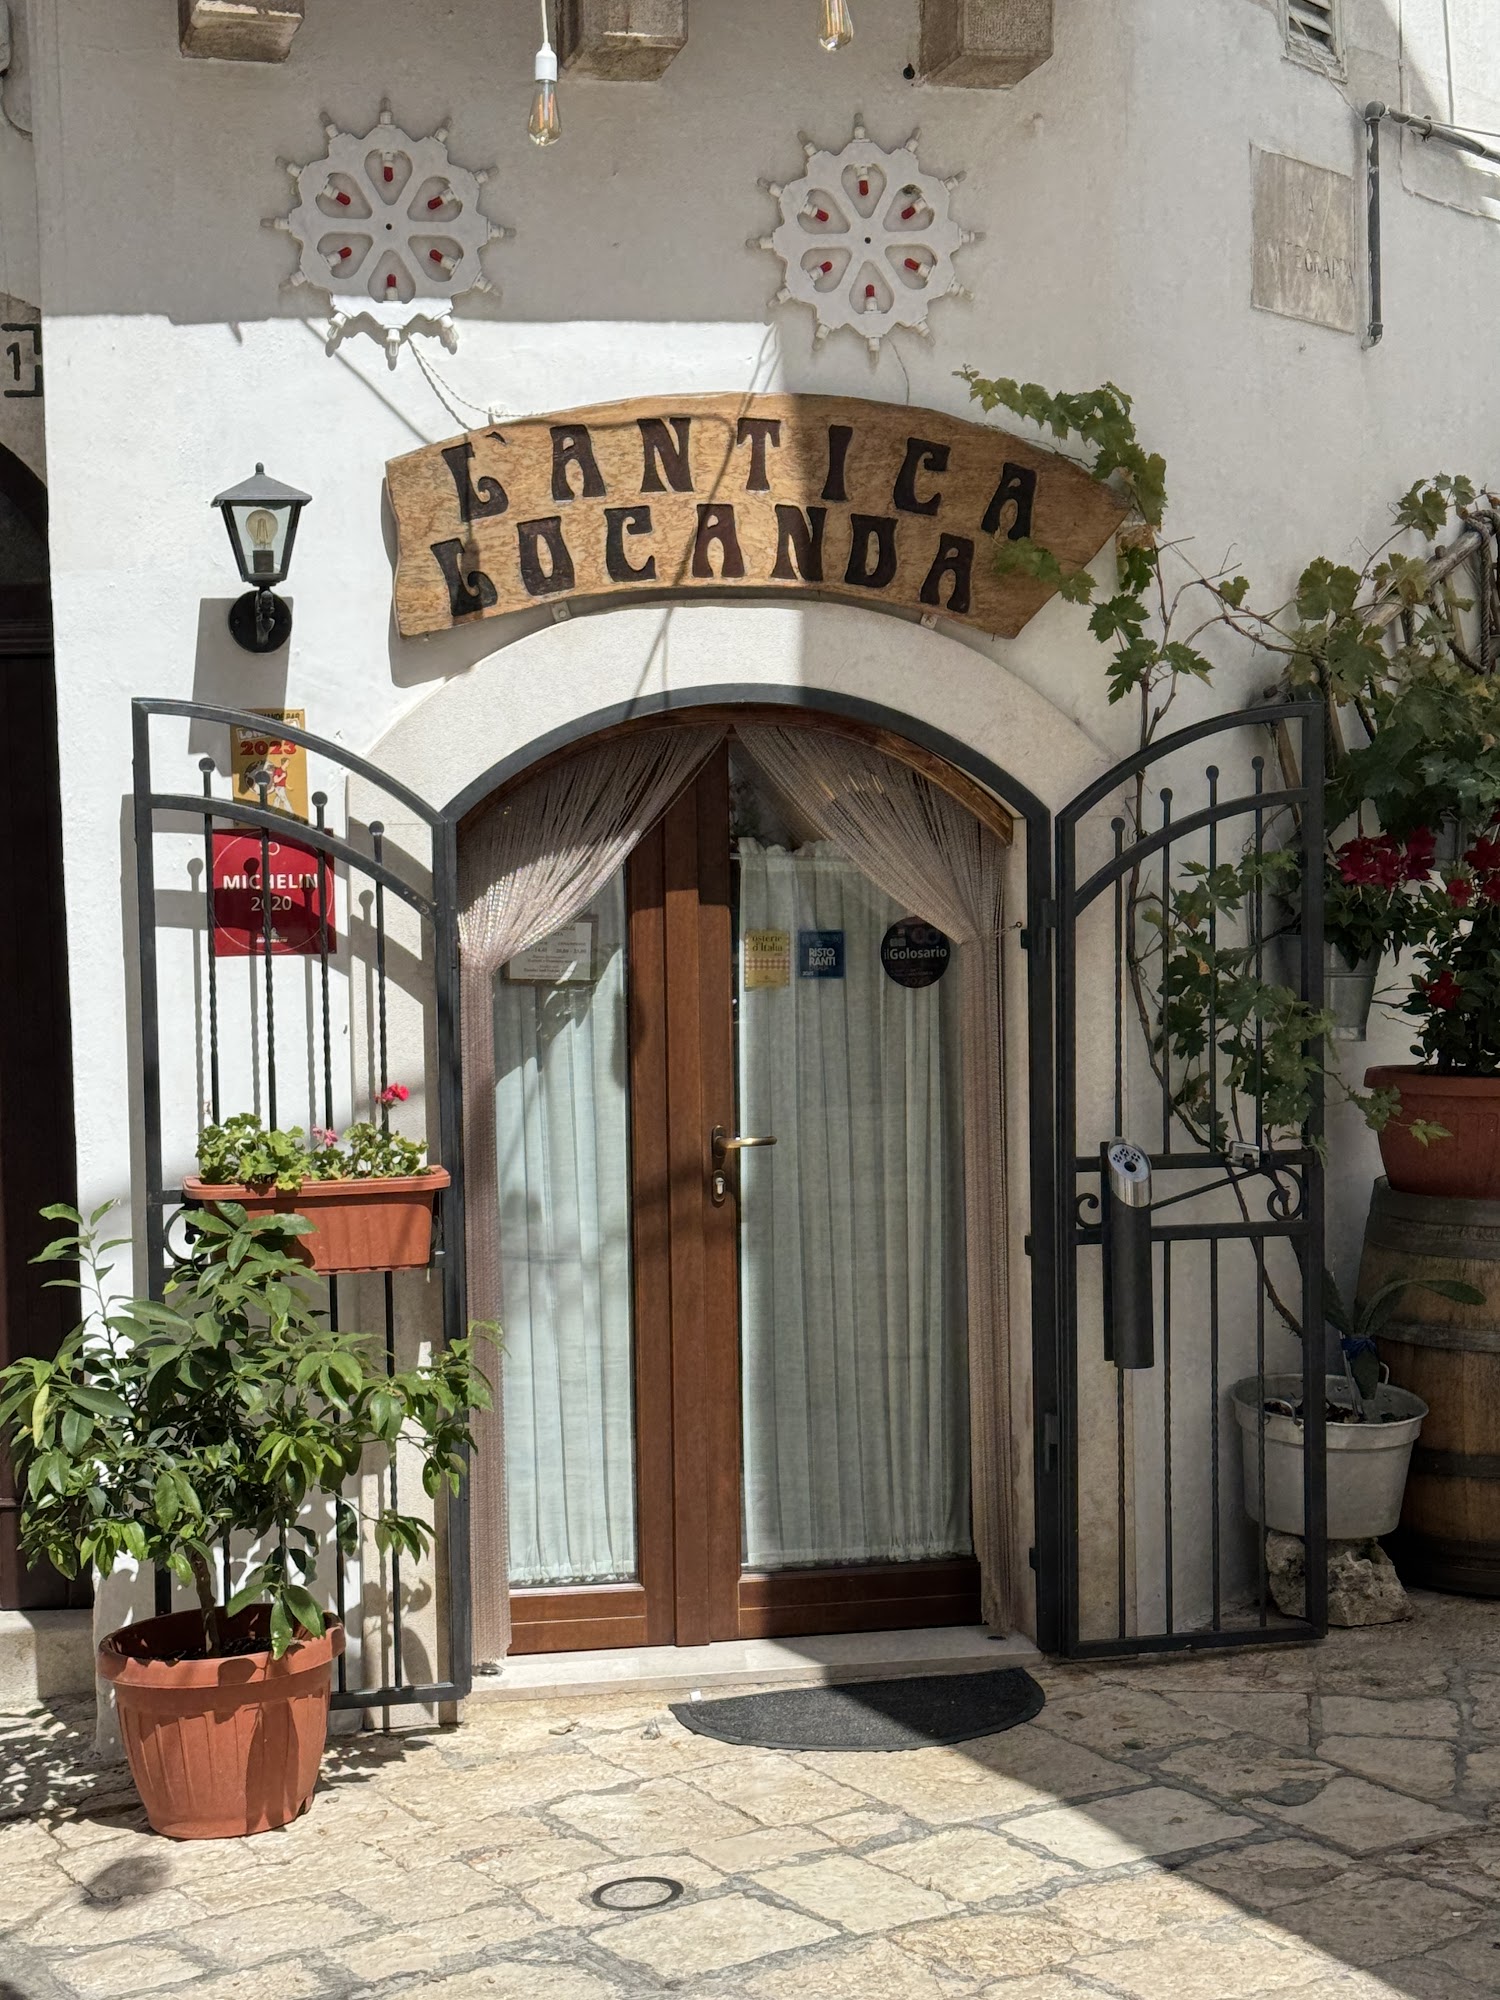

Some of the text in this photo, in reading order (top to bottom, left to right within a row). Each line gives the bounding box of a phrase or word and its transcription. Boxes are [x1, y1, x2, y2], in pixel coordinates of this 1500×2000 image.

[430, 503, 975, 616] LOCANDA
[240, 740, 297, 756] 2023
[809, 948, 835, 957] RISTO
[809, 957, 836, 966] RANTI
